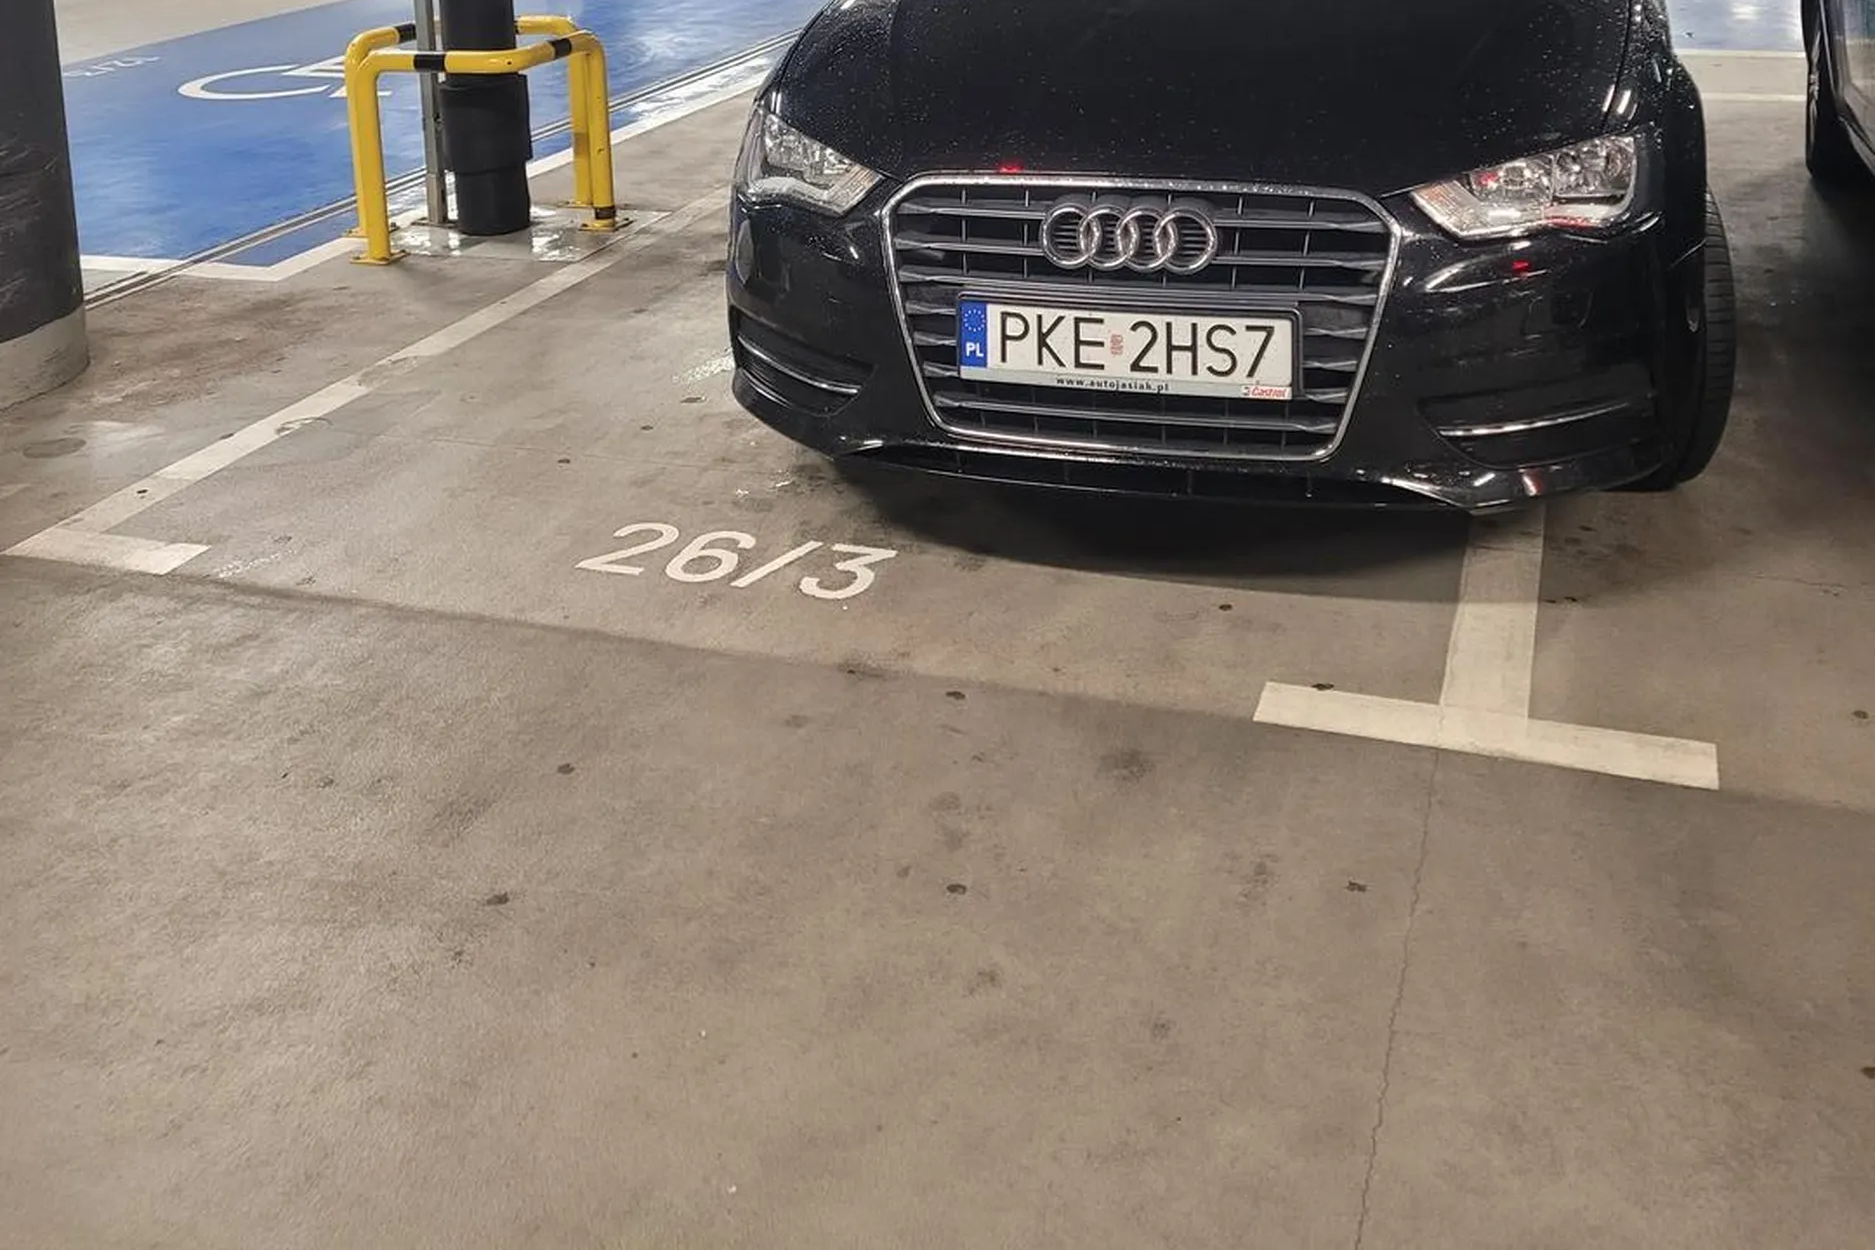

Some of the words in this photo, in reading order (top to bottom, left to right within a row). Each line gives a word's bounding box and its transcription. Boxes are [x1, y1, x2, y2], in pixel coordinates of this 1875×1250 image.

[965, 341, 984, 357] PL
[1000, 311, 1106, 371] PKE
[1129, 320, 1276, 379] 2HS7
[574, 522, 898, 600] 26/3
